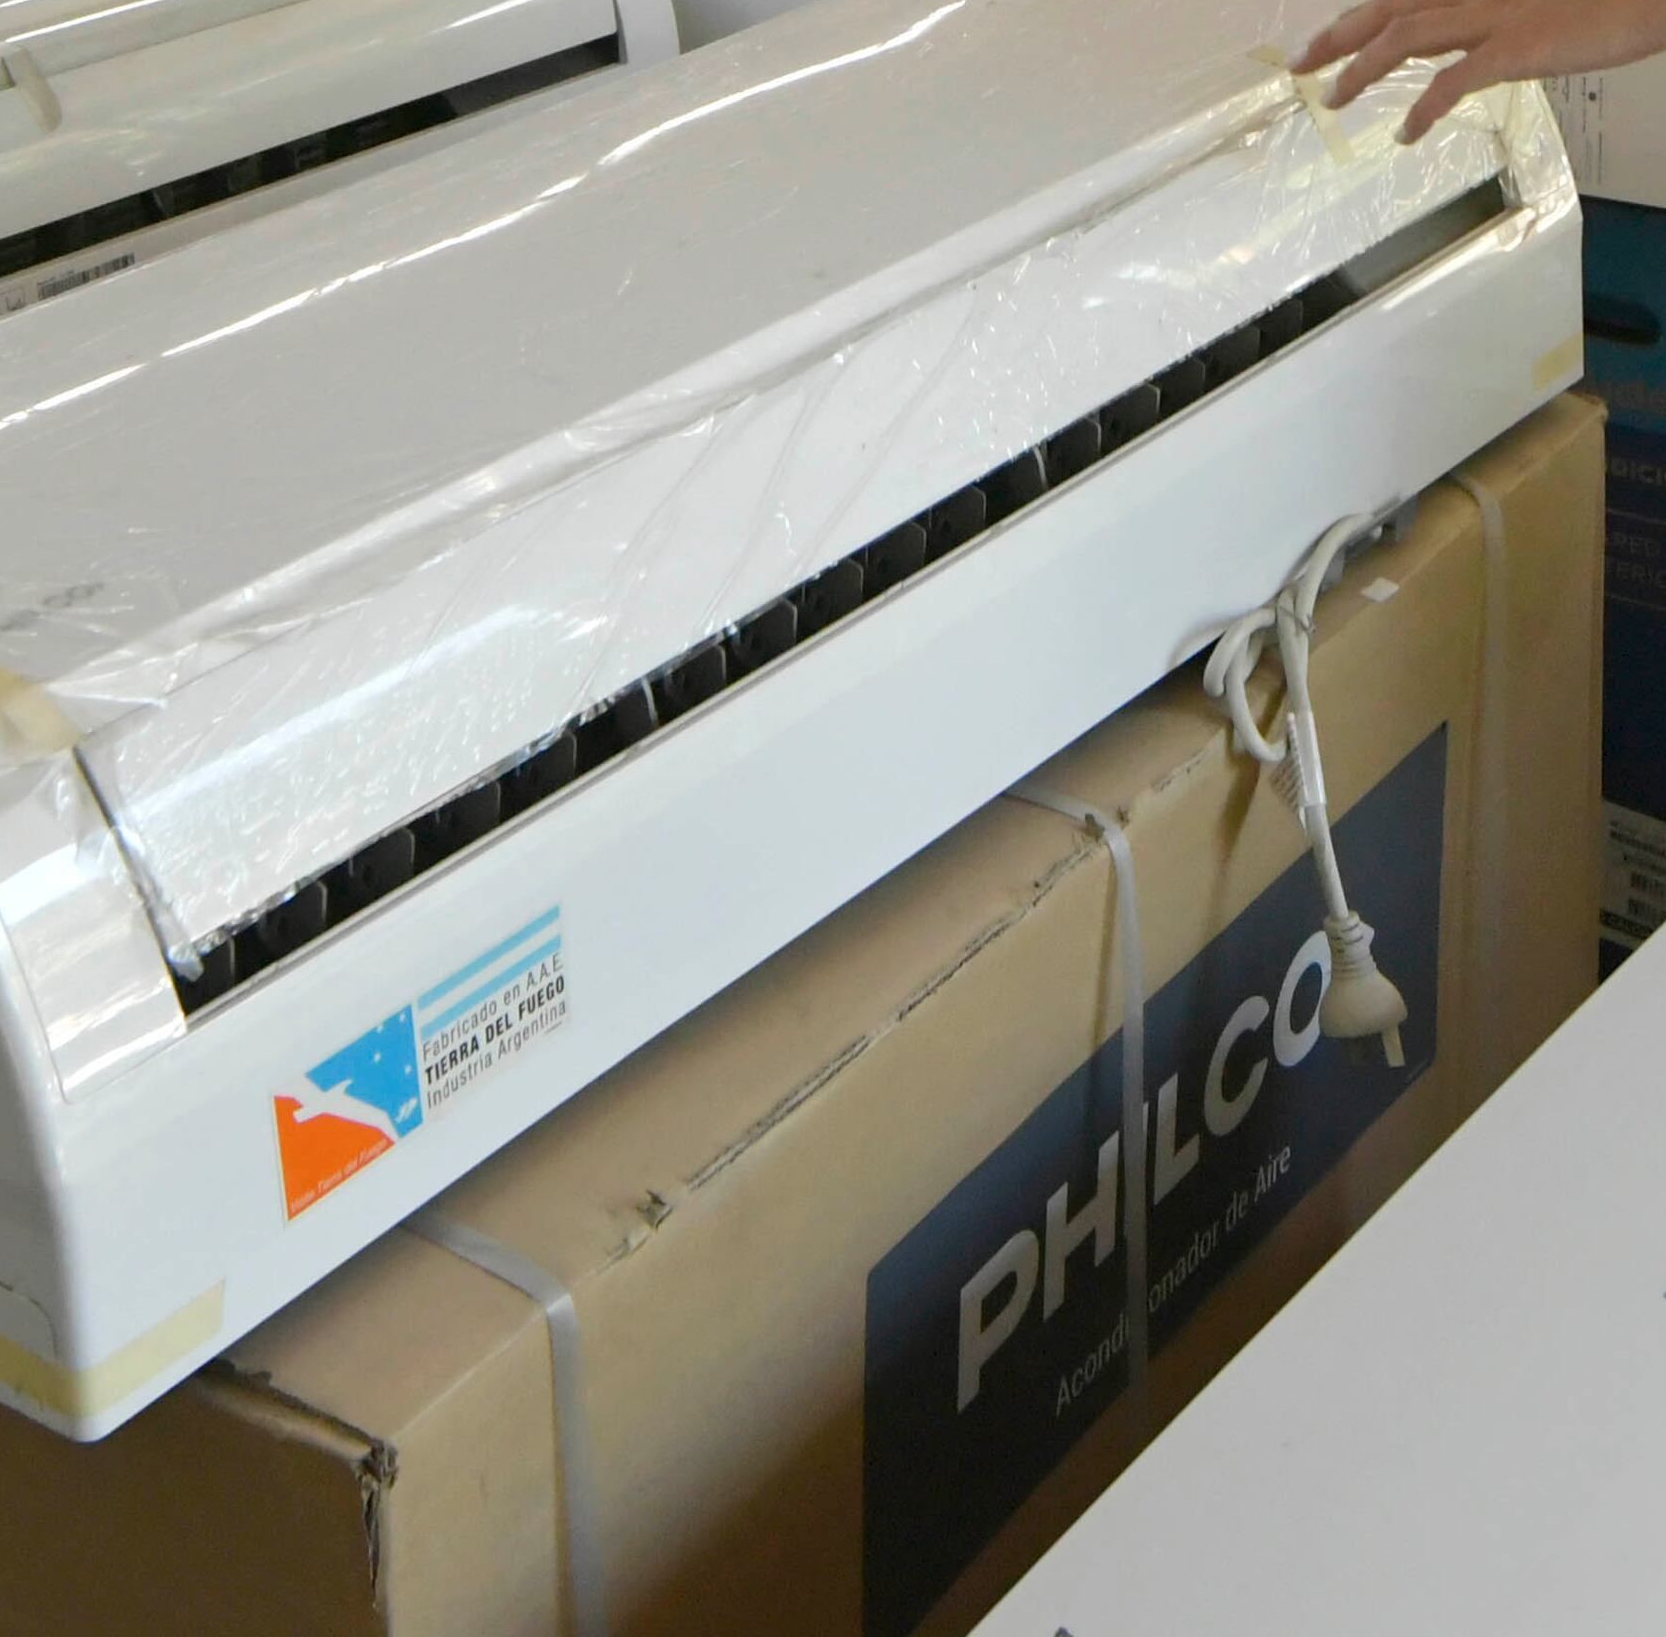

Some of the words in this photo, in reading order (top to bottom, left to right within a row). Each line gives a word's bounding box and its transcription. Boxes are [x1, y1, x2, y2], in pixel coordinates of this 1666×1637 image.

[1608, 530, 1660, 558] RED
[422, 998, 498, 1063] Fabricado
[503, 983, 522, 1007] en
[425, 1034, 480, 1086] TIERRA
[485, 1012, 514, 1044] DEL
[518, 974, 565, 1021] FUEGO
[427, 1051, 493, 1110] Industria
[498, 999, 566, 1060] Argentina
[957, 930, 1332, 1414] PHLCO
[1057, 1224, 1223, 1421] Acondionador
[1225, 1189, 1250, 1233] de
[1253, 1143, 1292, 1206] Aire
